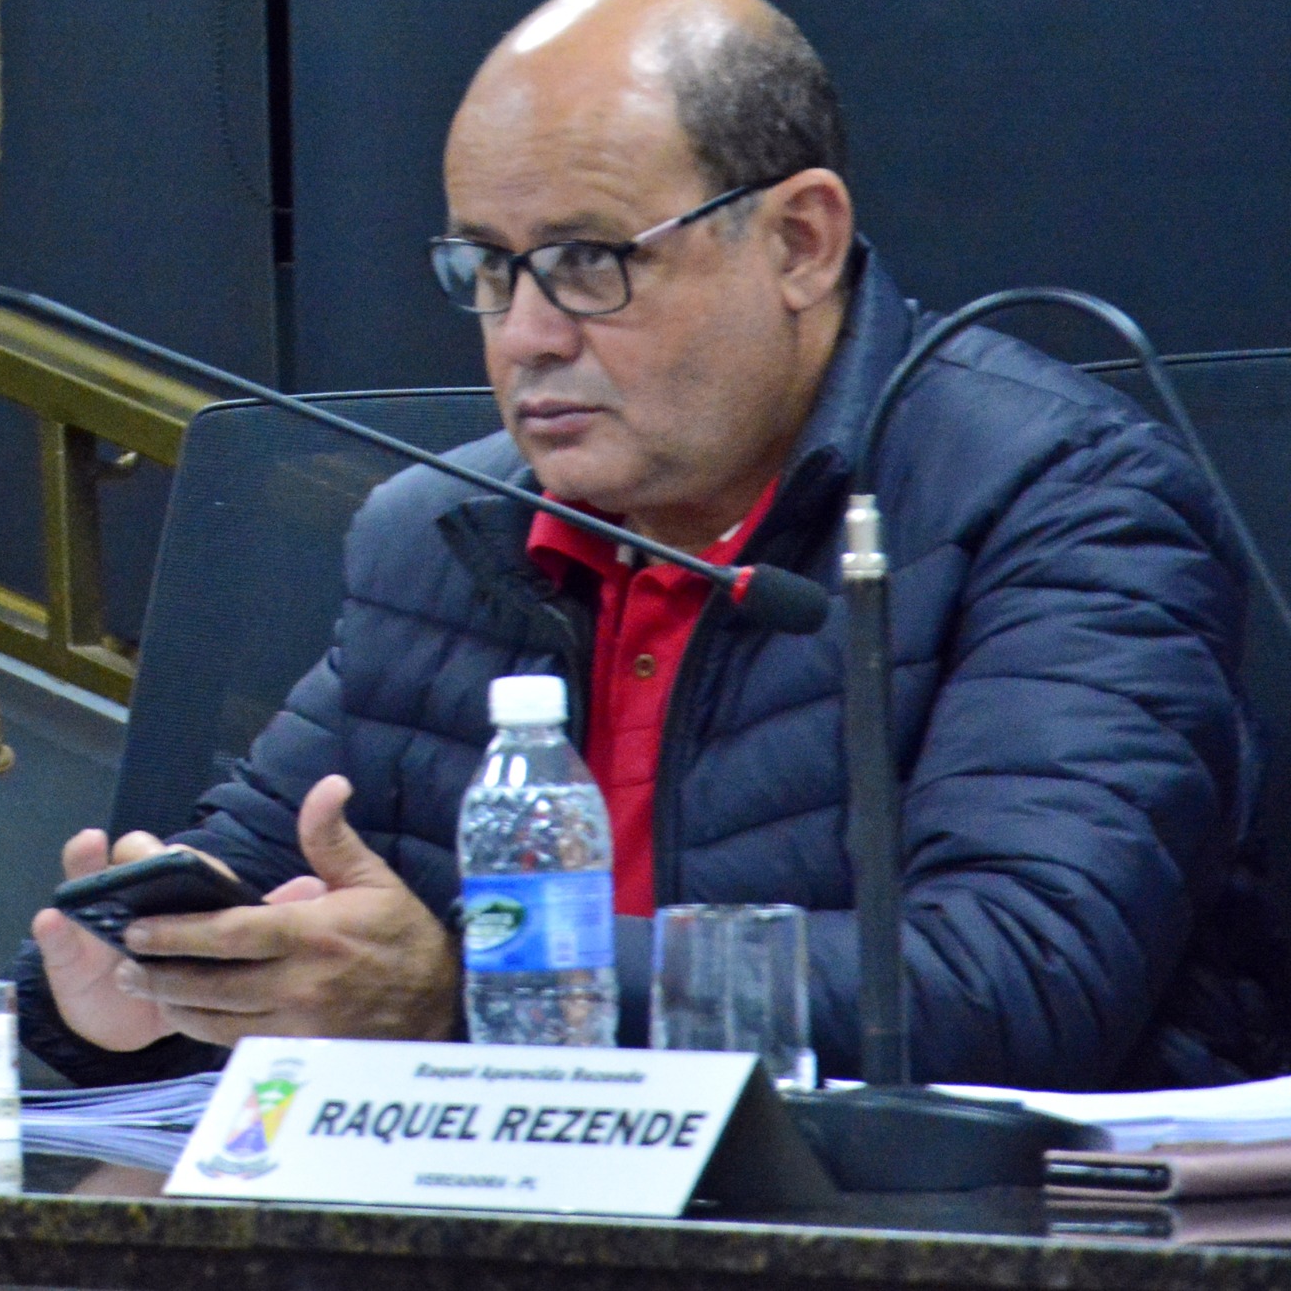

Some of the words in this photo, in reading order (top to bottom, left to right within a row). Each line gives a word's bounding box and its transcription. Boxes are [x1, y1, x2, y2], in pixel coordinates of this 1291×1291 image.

[415, 1062, 478, 1080] Raquel
[481, 1065, 566, 1082] Aparecida
[572, 1067, 643, 1084] Rezende
[310, 1101, 481, 1143] RAQUEL
[492, 1106, 710, 1148] REZENDE
